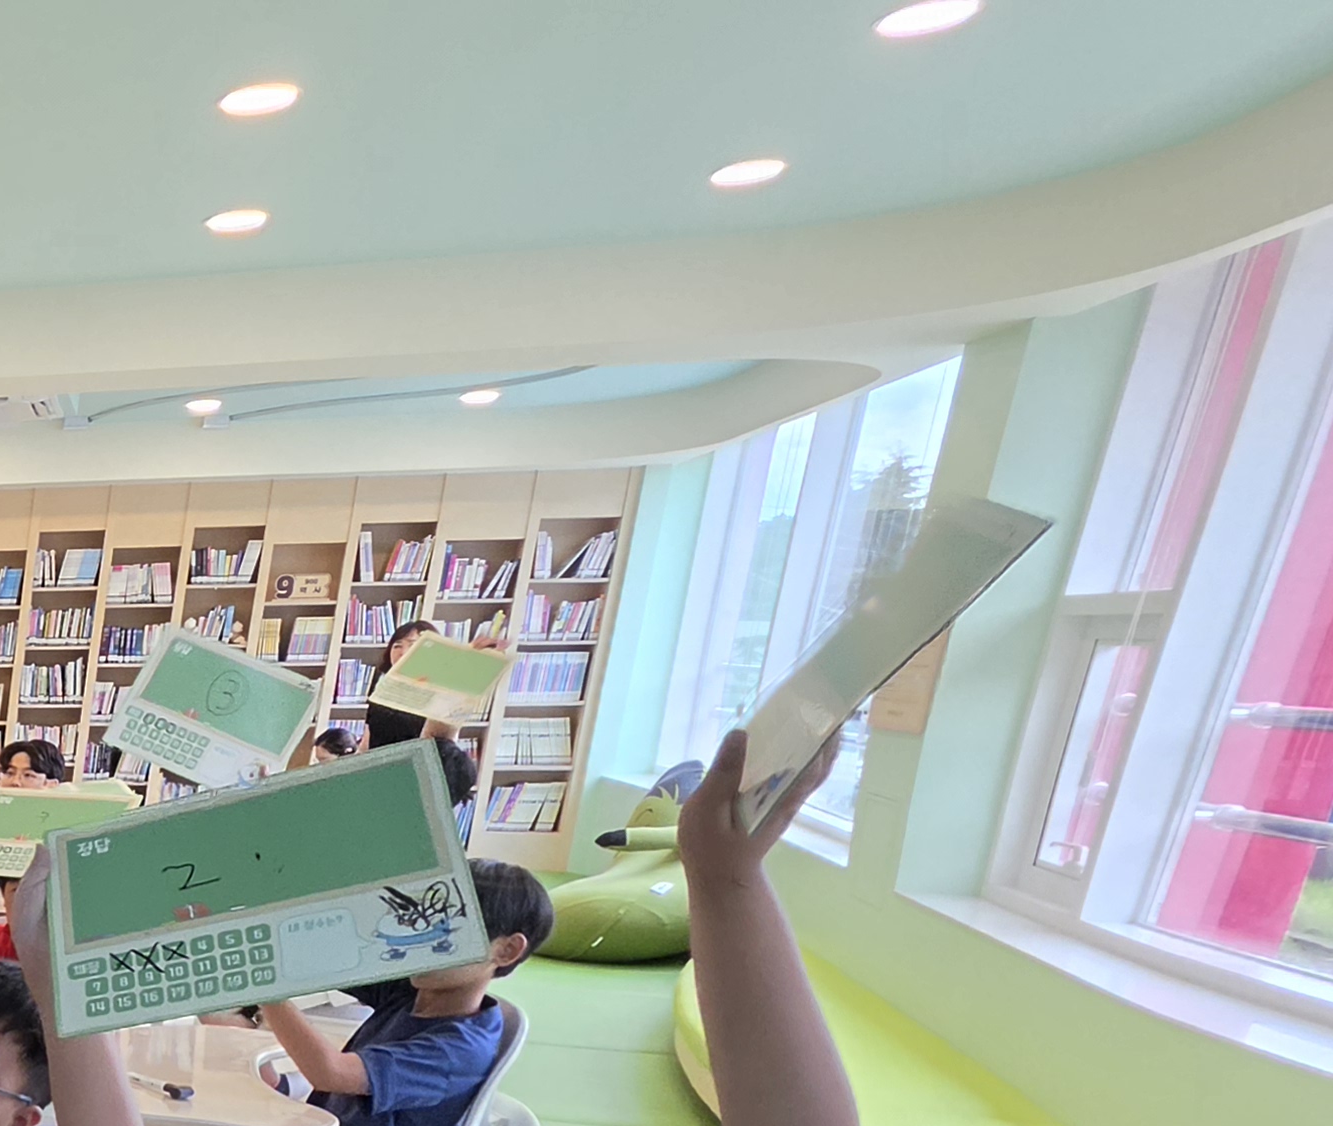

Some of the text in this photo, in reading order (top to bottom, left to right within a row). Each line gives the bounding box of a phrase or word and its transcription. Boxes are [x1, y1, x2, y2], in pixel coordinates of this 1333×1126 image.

[276, 575, 294, 599] 9
[76, 837, 111, 857] 정답
[161, 863, 222, 891] 2
[197, 929, 264, 951] 4 5 6
[92, 981, 101, 992] 7
[119, 976, 129, 987] 8
[145, 971, 154, 982] 9
[169, 966, 184, 977] 10
[198, 960, 211, 972] 11
[225, 954, 240, 966] 12
[253, 948, 269, 960] 13
[90, 969, 273, 1013] 14 15 16 17 18 19 20
